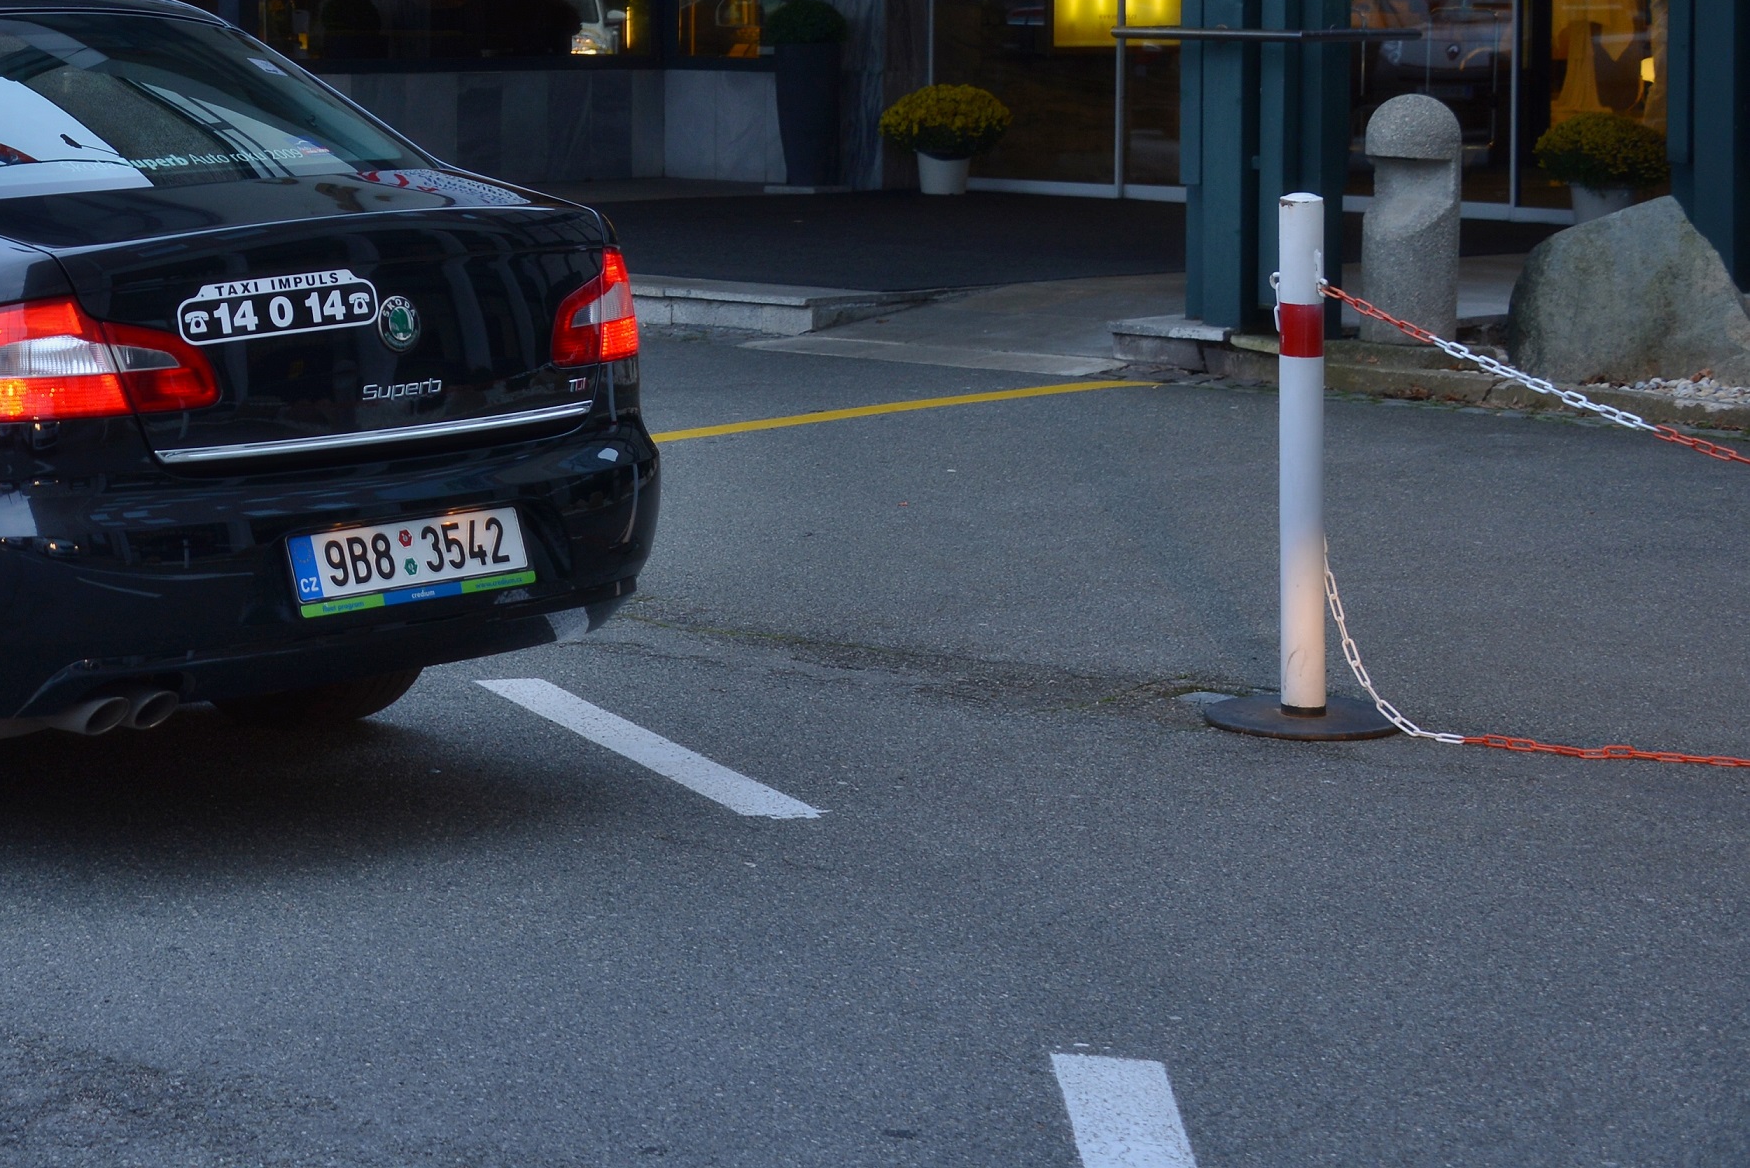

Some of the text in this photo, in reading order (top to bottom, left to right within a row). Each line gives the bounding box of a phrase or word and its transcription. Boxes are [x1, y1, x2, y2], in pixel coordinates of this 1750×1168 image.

[191, 152, 229, 166] Auto
[231, 150, 266, 165] roku
[265, 147, 305, 161] 2009
[214, 272, 339, 297] TAXI IMPULS
[213, 289, 346, 334] 14 0 14
[362, 377, 443, 401] Superb
[324, 516, 511, 587] 9B8 3542
[300, 577, 319, 593] CZ
[411, 589, 436, 599] credium
